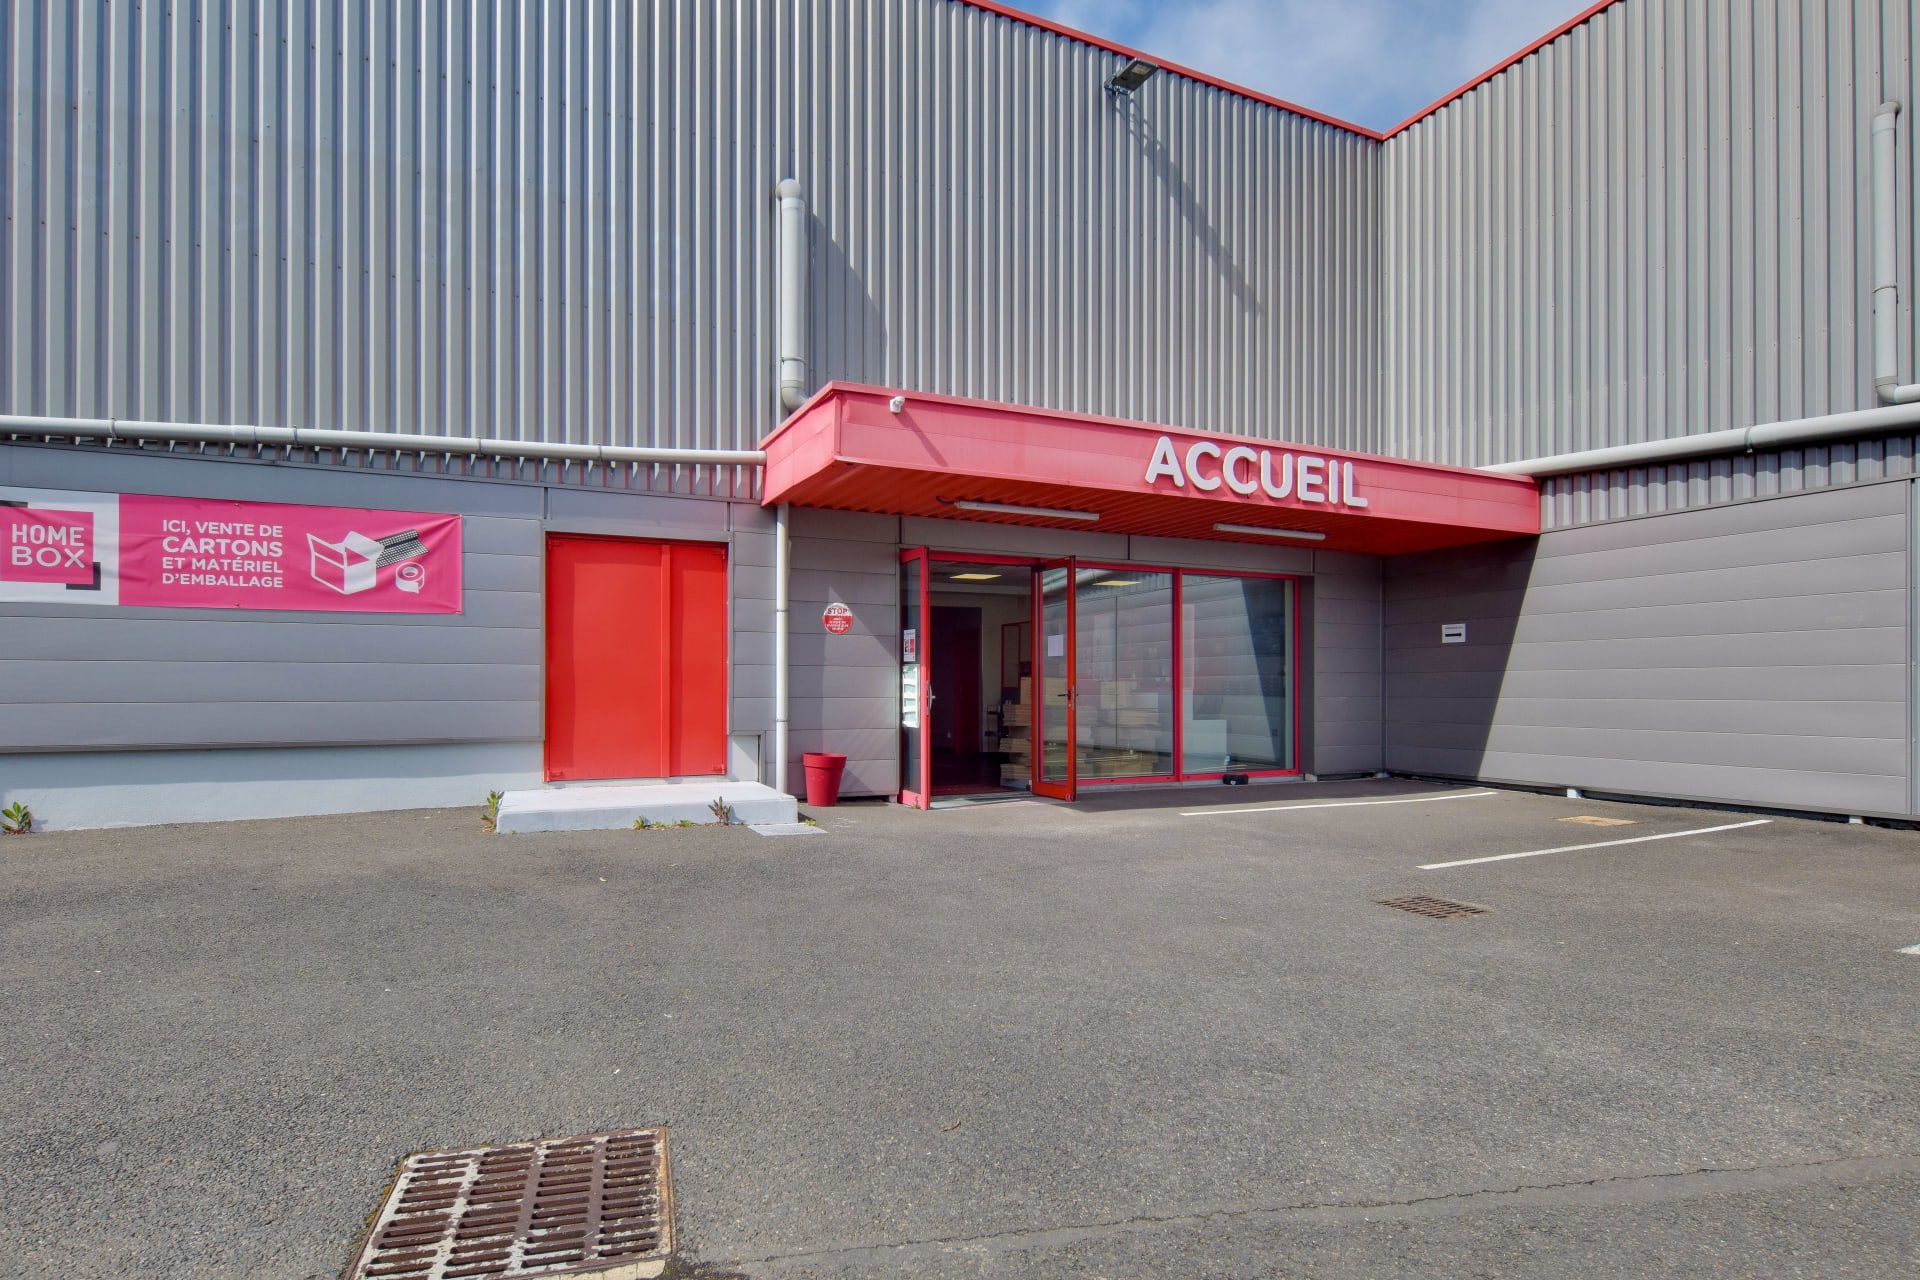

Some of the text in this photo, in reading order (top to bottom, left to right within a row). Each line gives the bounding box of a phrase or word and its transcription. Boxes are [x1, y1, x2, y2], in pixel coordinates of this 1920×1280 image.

[1144, 435, 1369, 507] ACCUEIL
[11, 523, 85, 547] HOME
[162, 519, 283, 538] ICI, VENTE DE
[162, 536, 283, 557] CARTONS
[11, 545, 85, 569] BOX
[162, 556, 284, 574] ET MATÉRIEL
[162, 572, 284, 588] D’EMBALLAGE
[827, 607, 848, 615] STOP
